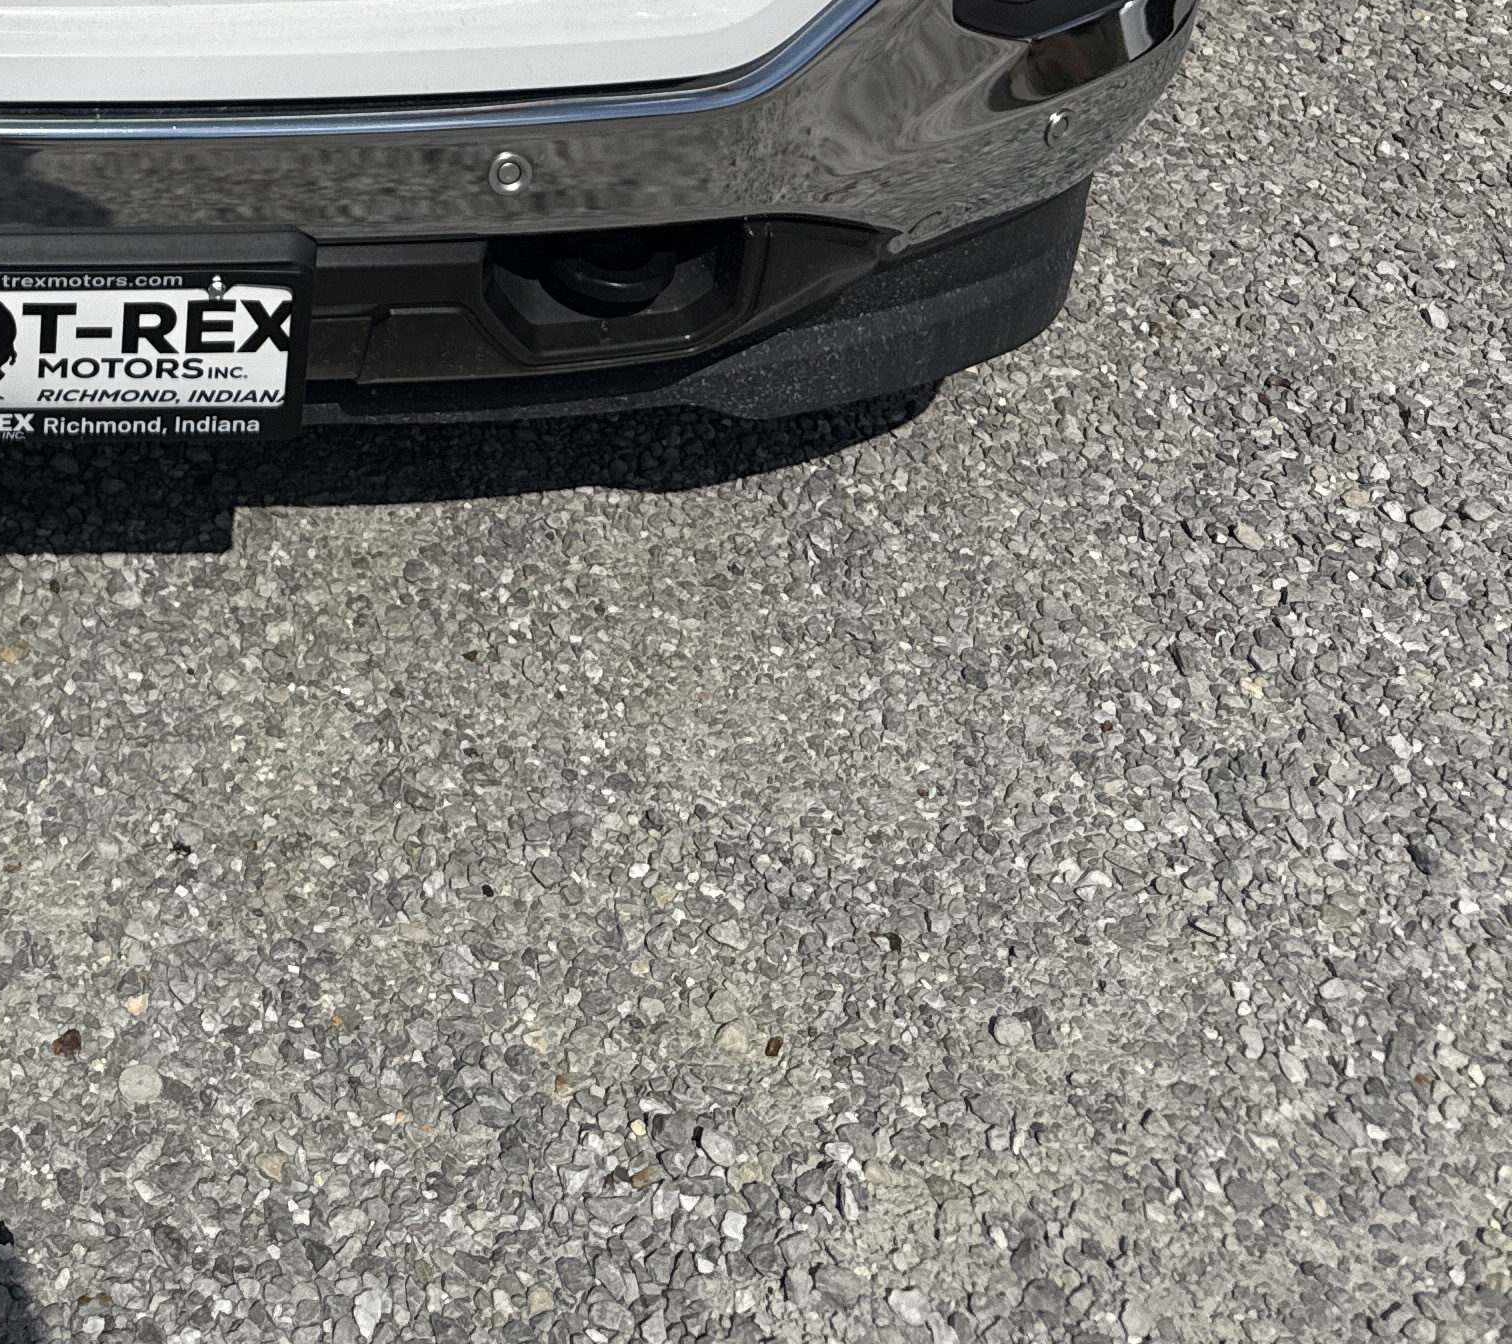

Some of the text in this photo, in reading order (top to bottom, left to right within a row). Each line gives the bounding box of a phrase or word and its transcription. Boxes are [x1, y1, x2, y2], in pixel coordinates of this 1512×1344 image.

[2, 274, 183, 289] trexmotors.com
[23, 299, 293, 354] T-REX
[38, 357, 248, 379] MOTORS INC.
[37, 388, 182, 404] RICHMOND,
[43, 417, 167, 436] Richmond,
[175, 415, 260, 433] Indiana
